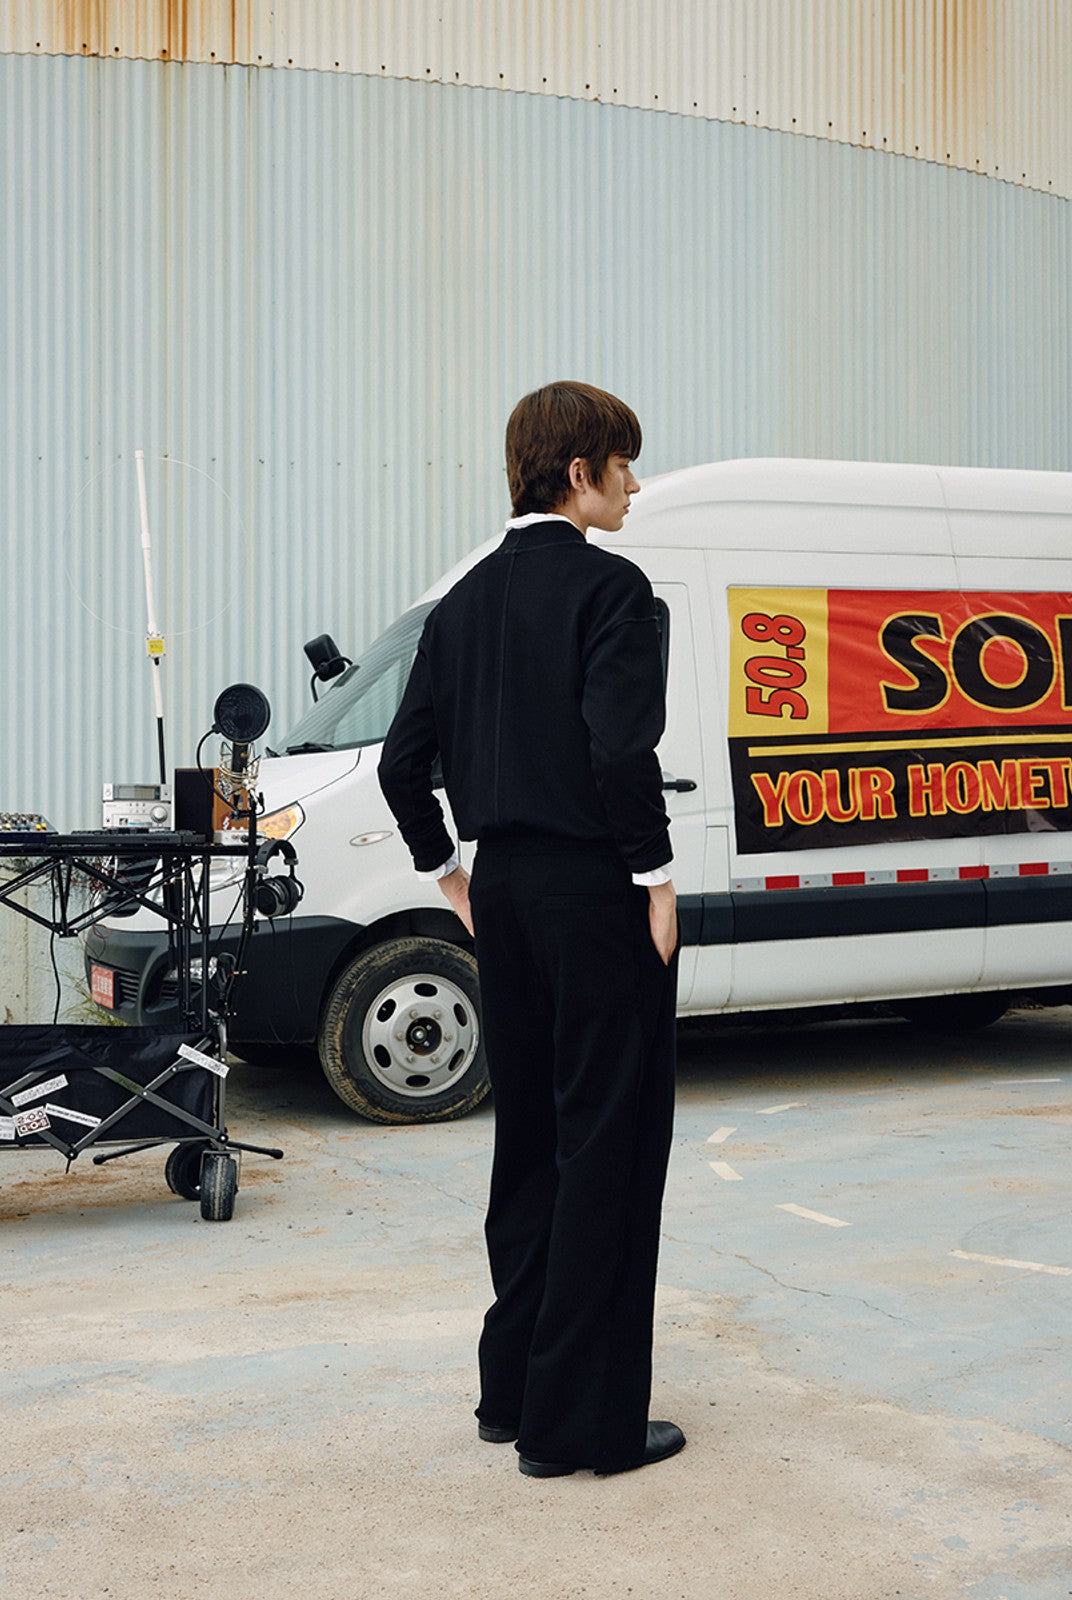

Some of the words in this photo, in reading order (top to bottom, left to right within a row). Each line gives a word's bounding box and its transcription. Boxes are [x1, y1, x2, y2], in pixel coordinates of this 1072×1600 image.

[741, 612, 808, 719] 50.8
[878, 611, 1072, 715] SO
[750, 767, 897, 827] YOUR
[907, 757, 1072, 817] HOMET
